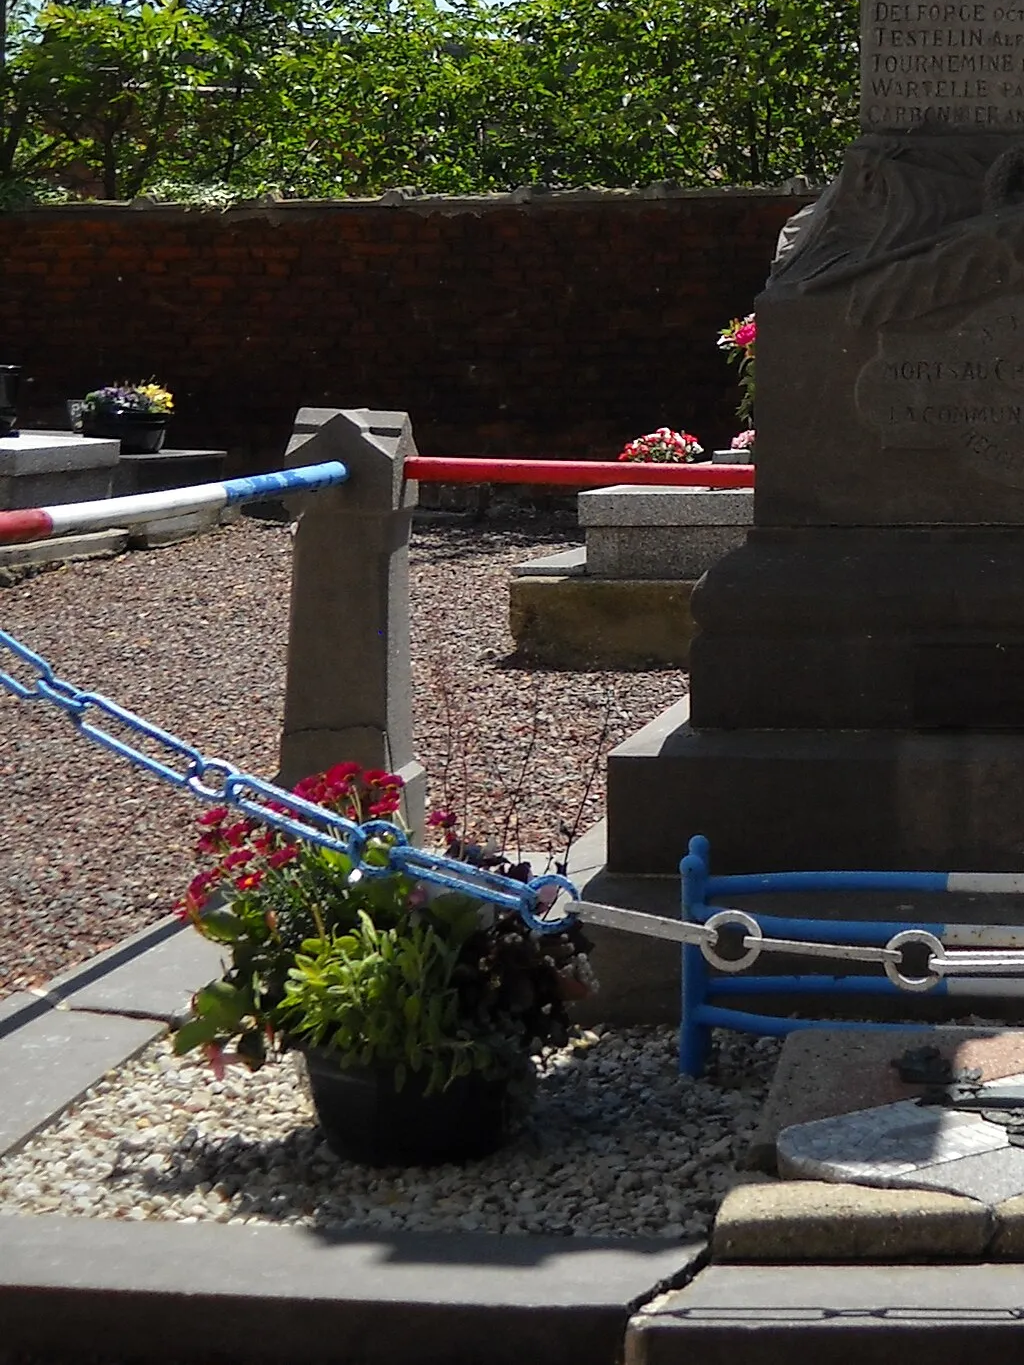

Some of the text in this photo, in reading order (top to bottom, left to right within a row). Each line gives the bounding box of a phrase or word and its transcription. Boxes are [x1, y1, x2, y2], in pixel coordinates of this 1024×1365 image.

[874, 1, 986, 22] DELFORGE
[874, 27, 983, 47] TESTELIN
[871, 54, 1013, 73] TOURNEMINE
[871, 78, 988, 98] WARTELLE
[884, 361, 958, 382] MORTS
[962, 361, 988, 381] AU
